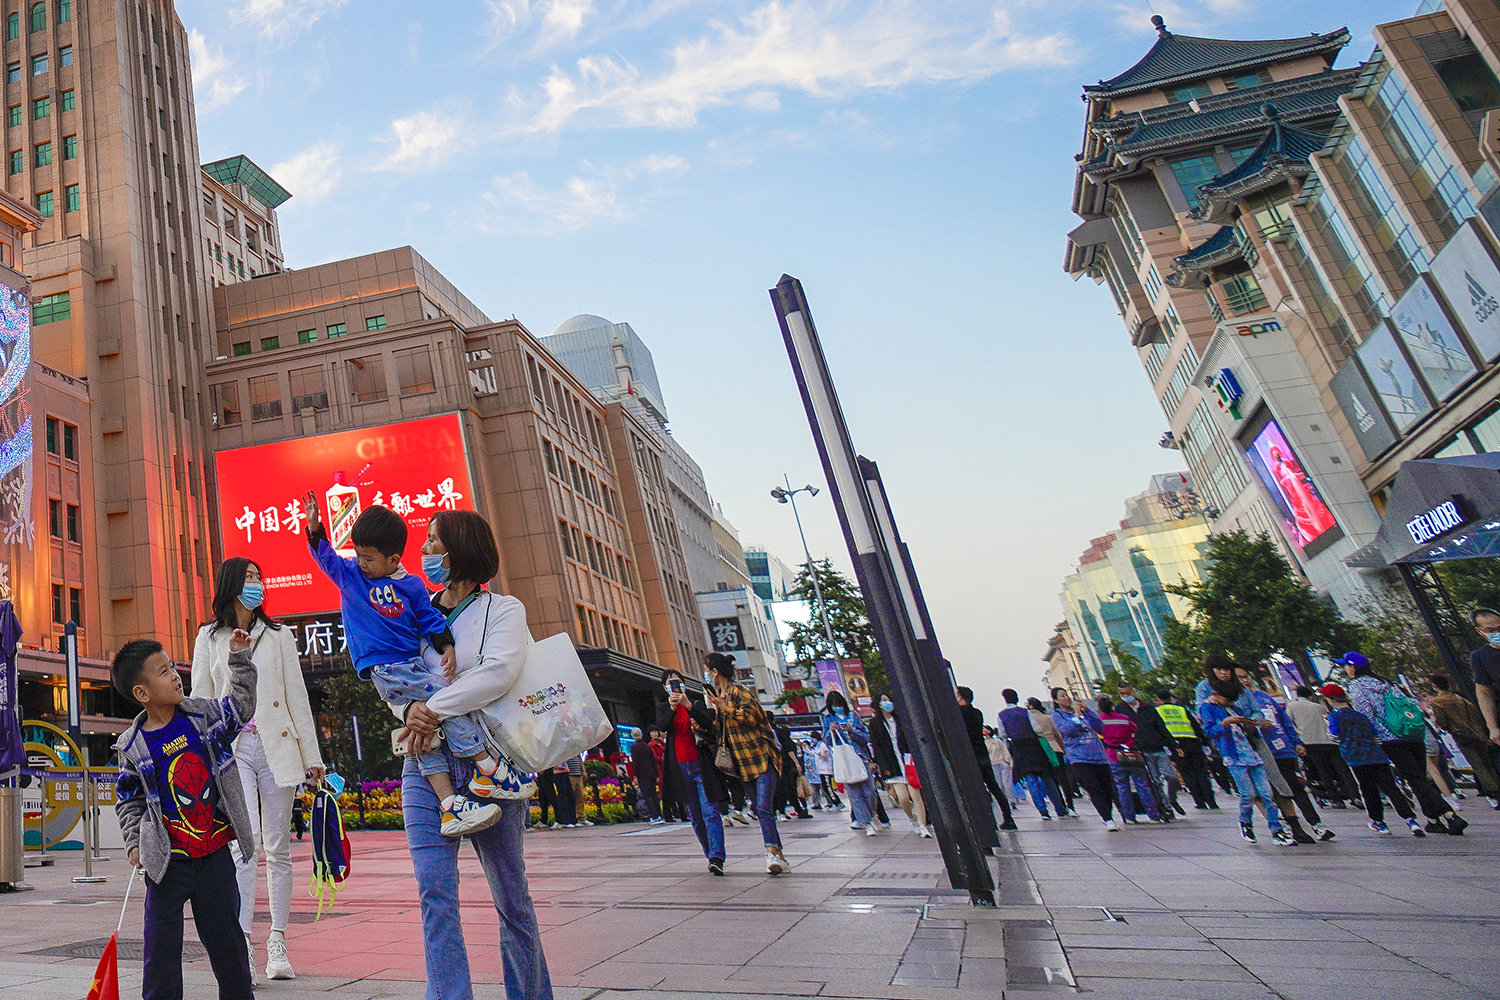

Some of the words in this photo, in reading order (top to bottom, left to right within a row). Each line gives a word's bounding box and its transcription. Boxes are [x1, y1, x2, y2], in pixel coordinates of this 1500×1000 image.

[1236, 321, 1282, 339] apm
[235, 498, 322, 543] 中国茅
[369, 583, 402, 605] COOL
[712, 622, 738, 648] 药
[162, 734, 188, 753] AMAZING
